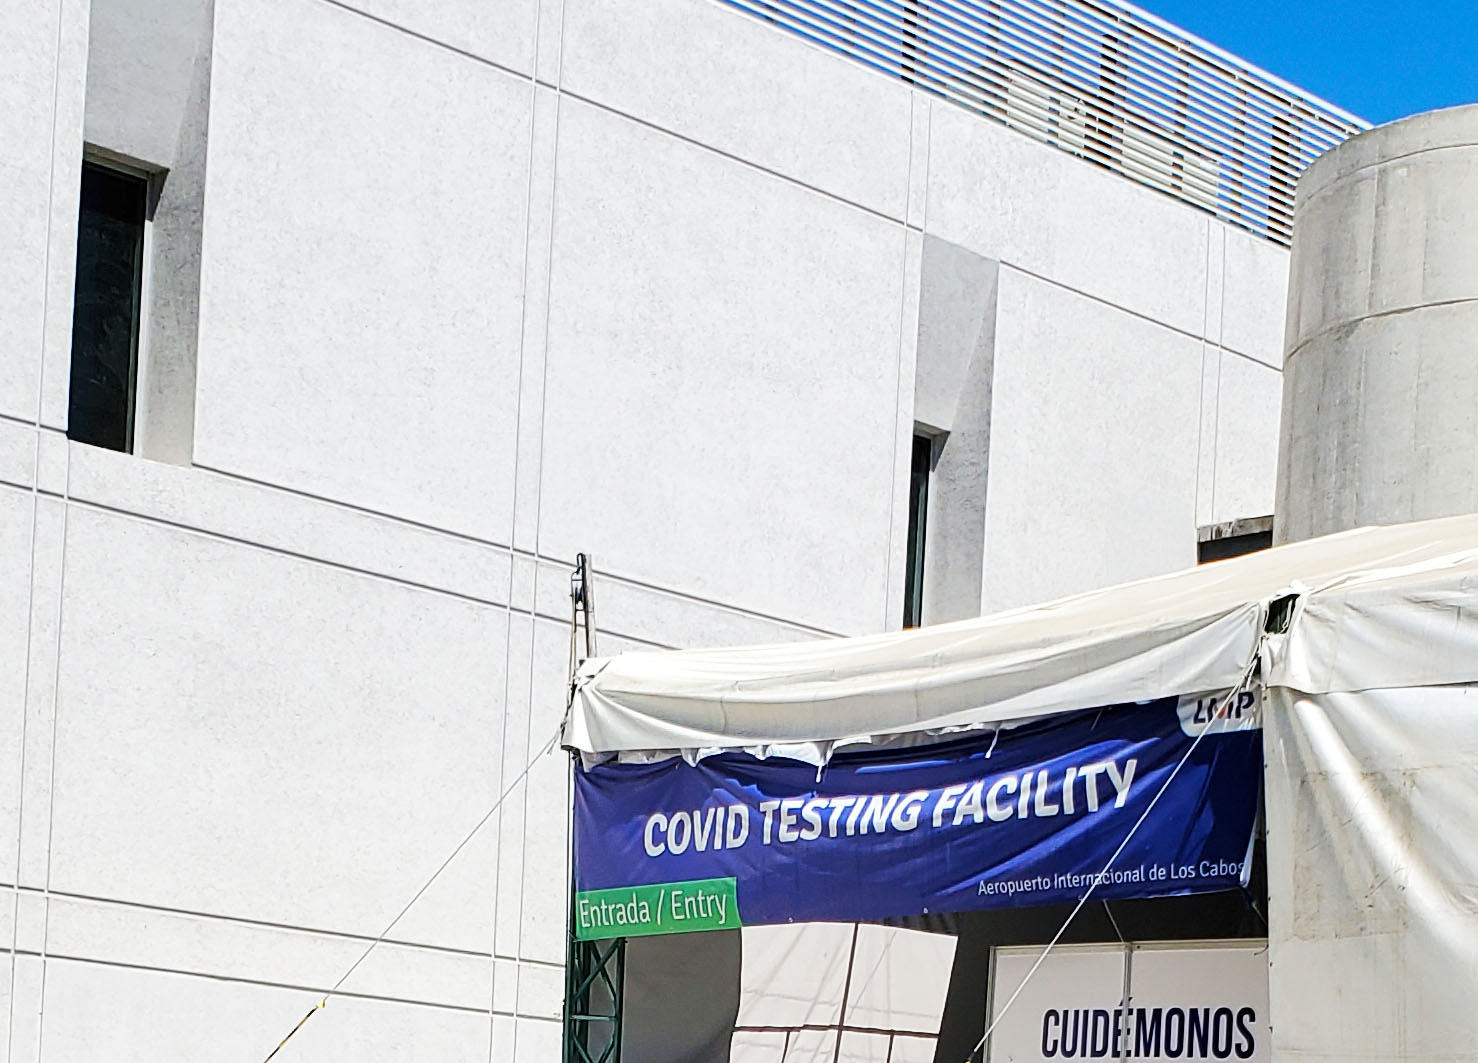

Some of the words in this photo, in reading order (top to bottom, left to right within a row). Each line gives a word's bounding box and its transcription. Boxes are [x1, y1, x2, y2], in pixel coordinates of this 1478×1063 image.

[644, 804, 750, 858] COVID
[761, 792, 926, 846] TESTING
[932, 758, 1138, 828] FACILITY
[978, 875, 1051, 896] Aeropuerto
[1053, 864, 1146, 889] Internacional
[1149, 867, 1167, 882] de
[1170, 864, 1196, 880] Los
[1199, 858, 1245, 878] Cabos
[579, 891, 651, 928] Entrada
[656, 889, 665, 925] /
[671, 889, 727, 925] Entry
[1041, 997, 1256, 1059] CUIDÉMONOS
